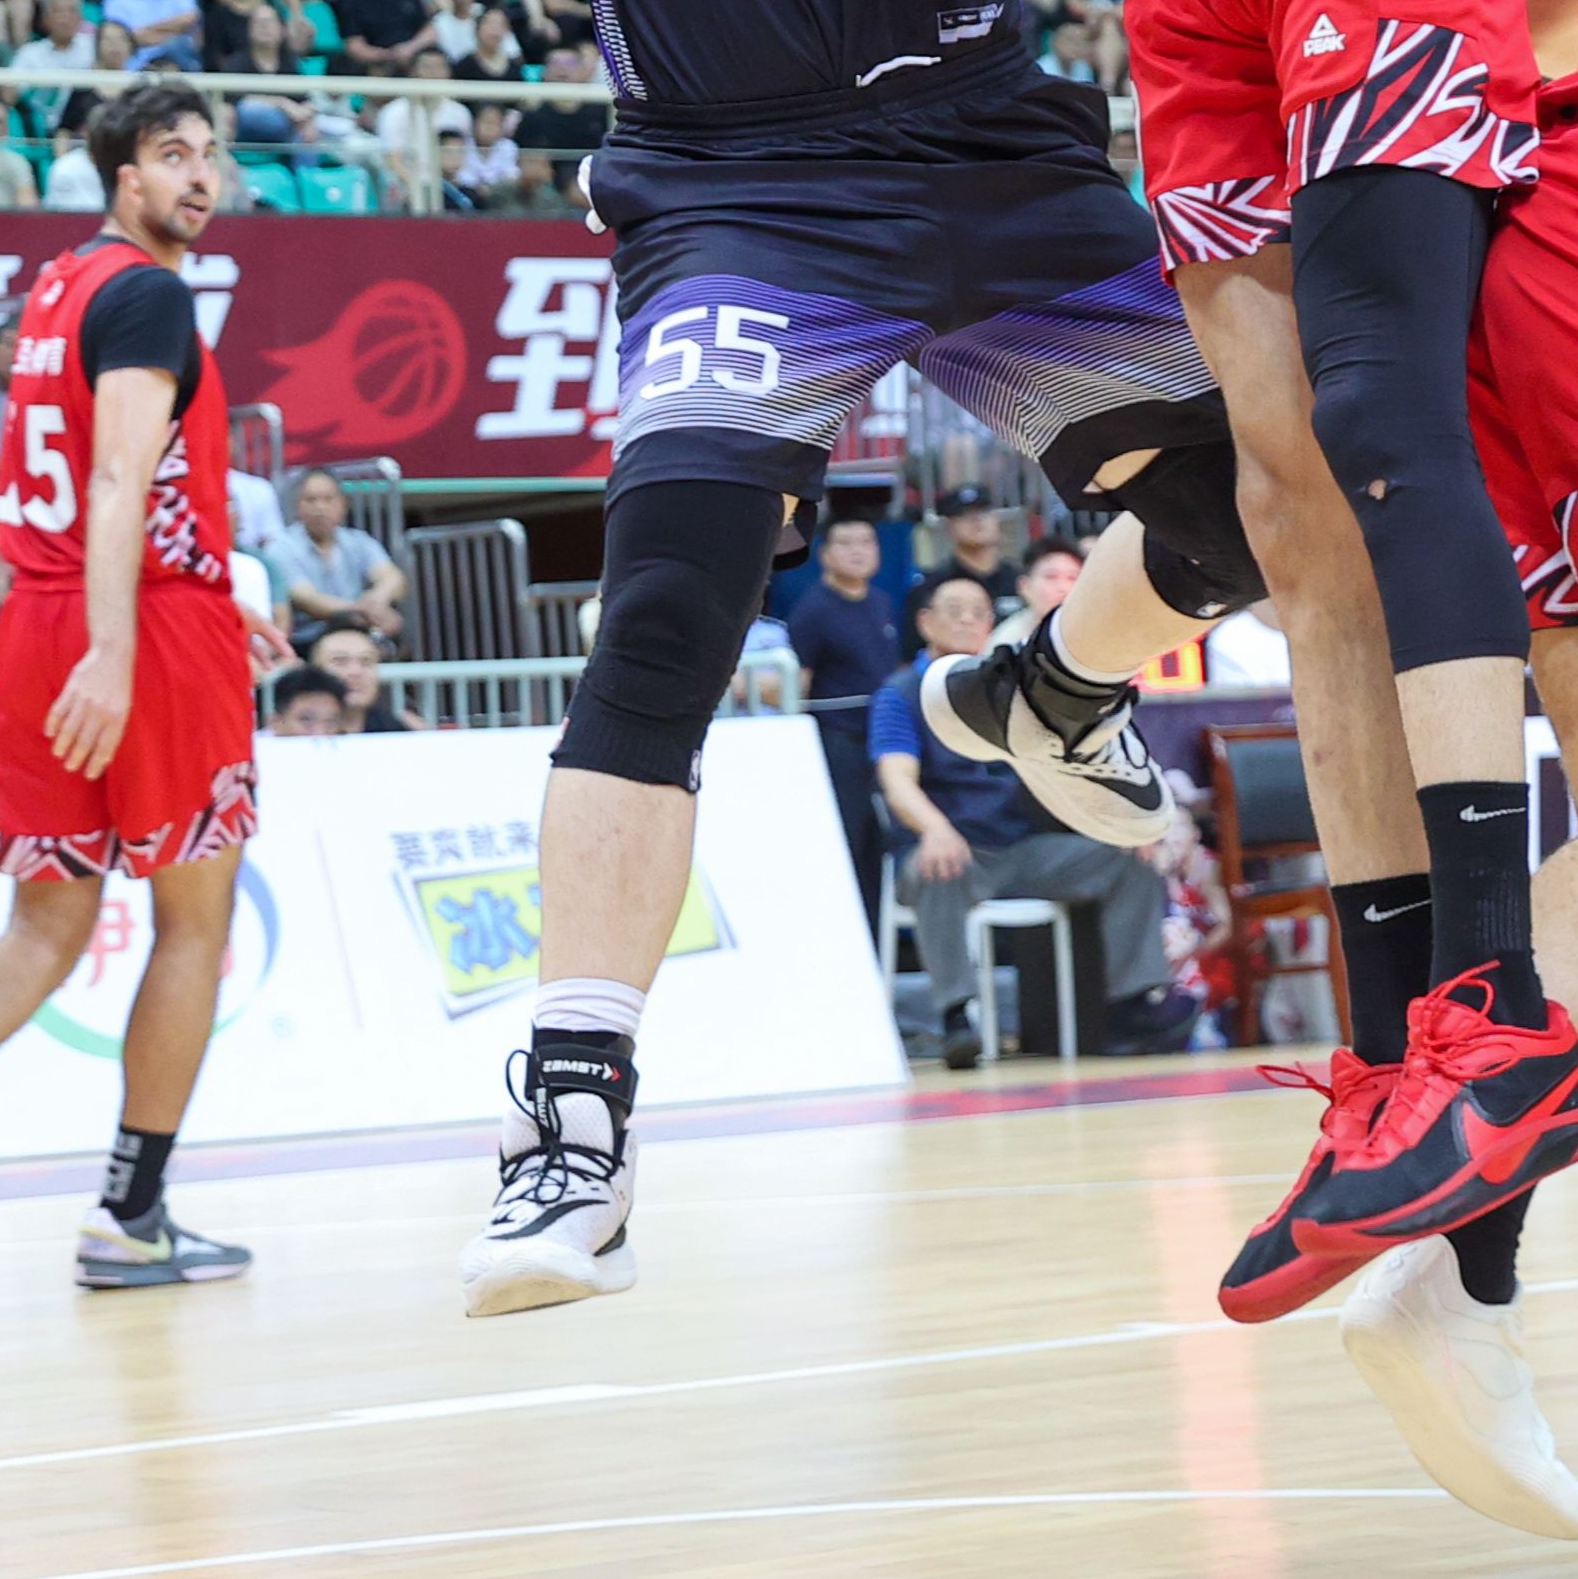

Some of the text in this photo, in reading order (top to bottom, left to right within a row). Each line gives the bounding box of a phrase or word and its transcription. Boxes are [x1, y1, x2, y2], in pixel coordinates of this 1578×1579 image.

[1302, 33, 1347, 59] PEAK
[639, 304, 791, 402] 55
[434, 883, 542, 976] 冰
